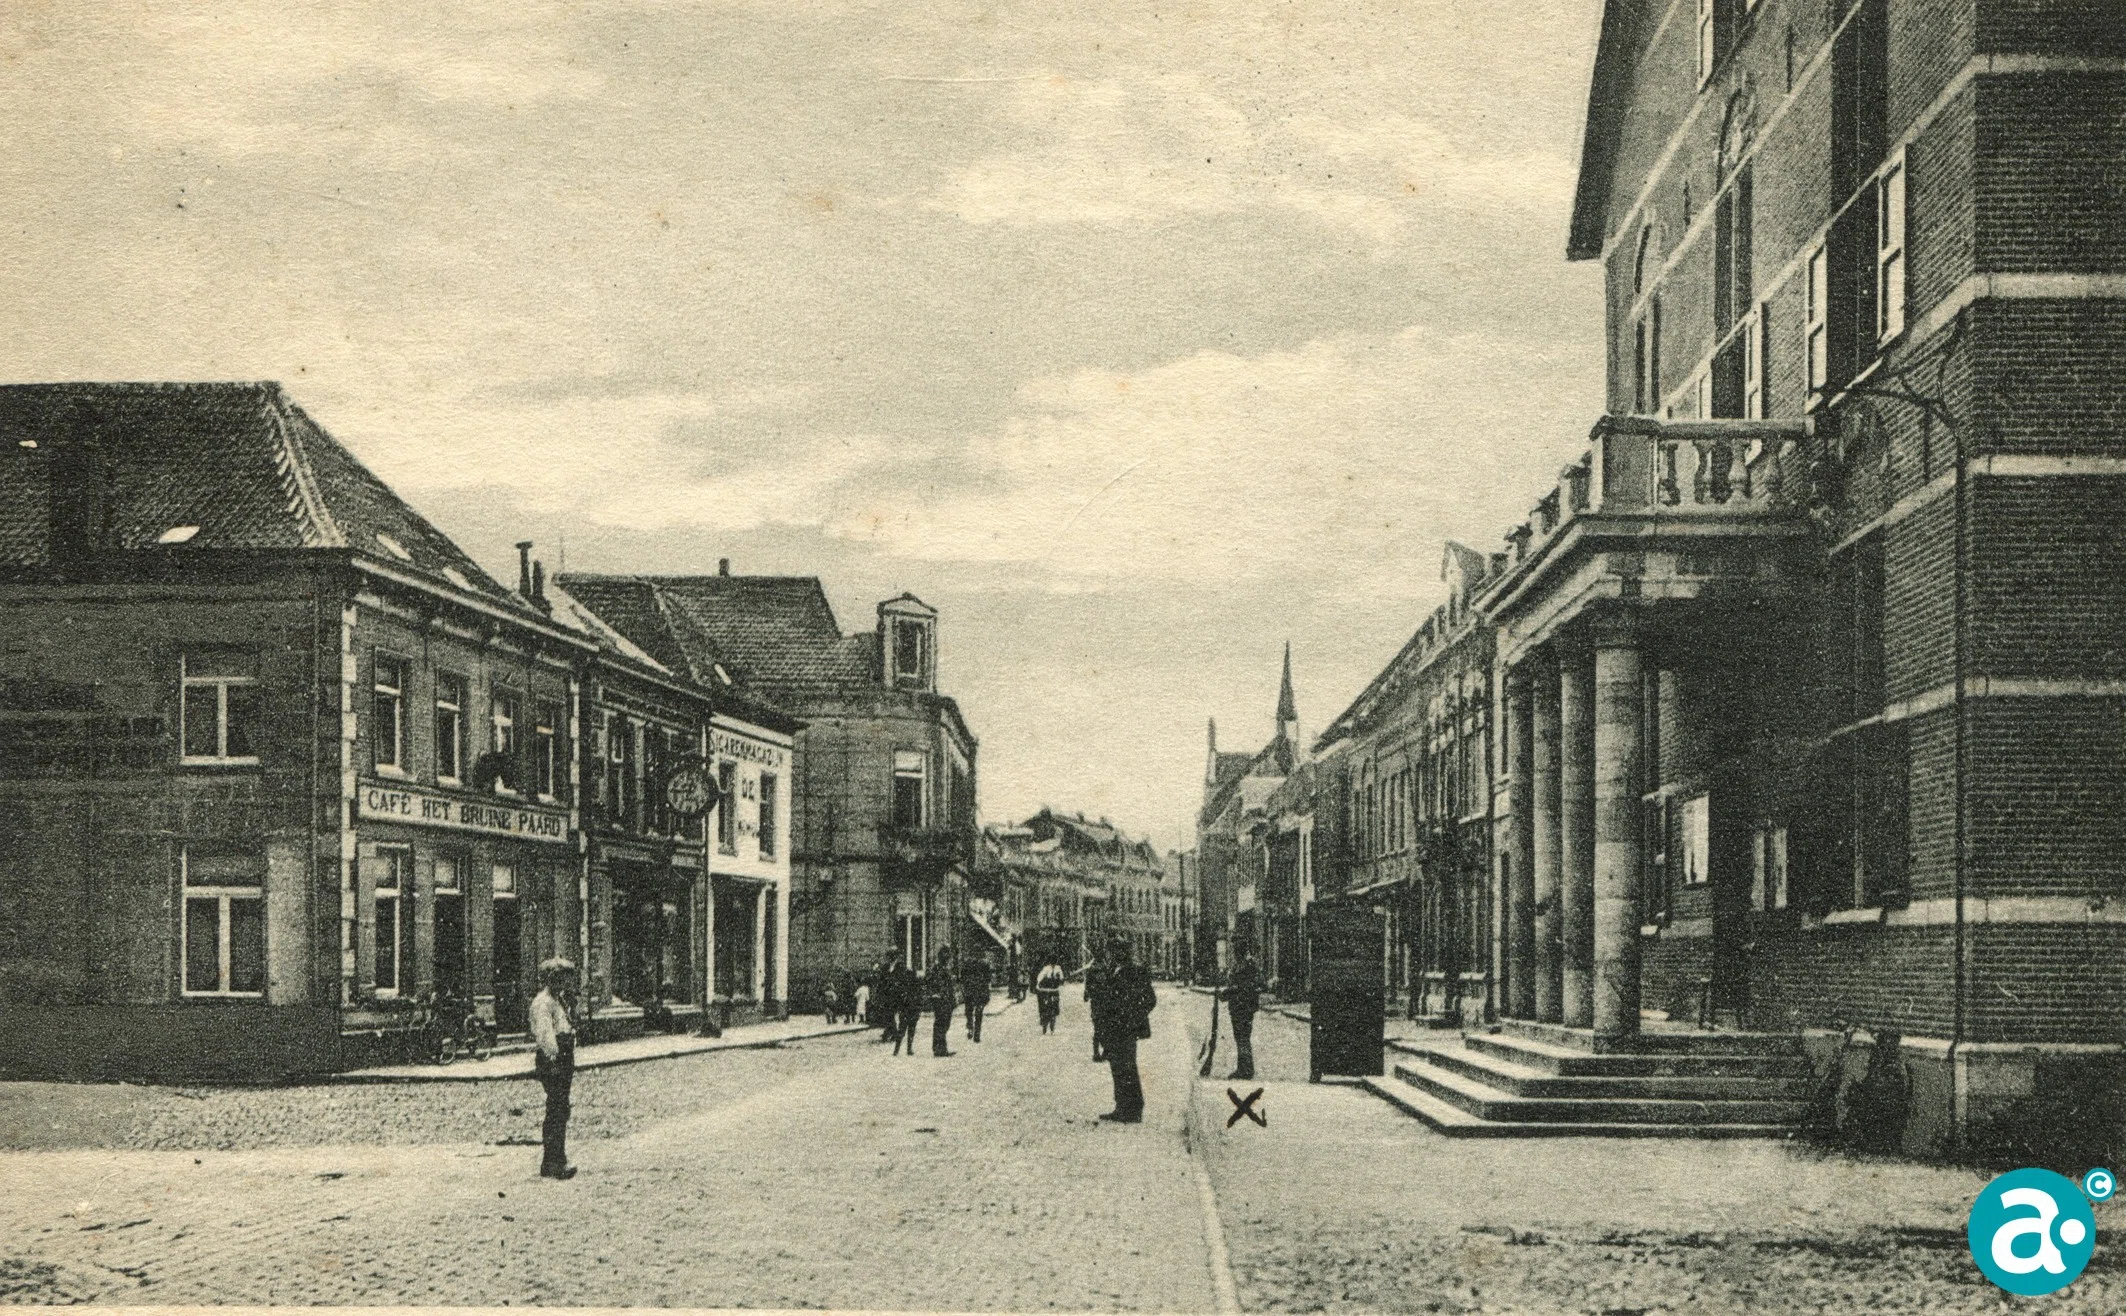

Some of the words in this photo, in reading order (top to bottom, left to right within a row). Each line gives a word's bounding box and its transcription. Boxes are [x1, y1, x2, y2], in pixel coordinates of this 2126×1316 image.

[421, 798, 452, 821] HET
[460, 803, 512, 831] BRUINE
[518, 812, 561, 837] PAARD
